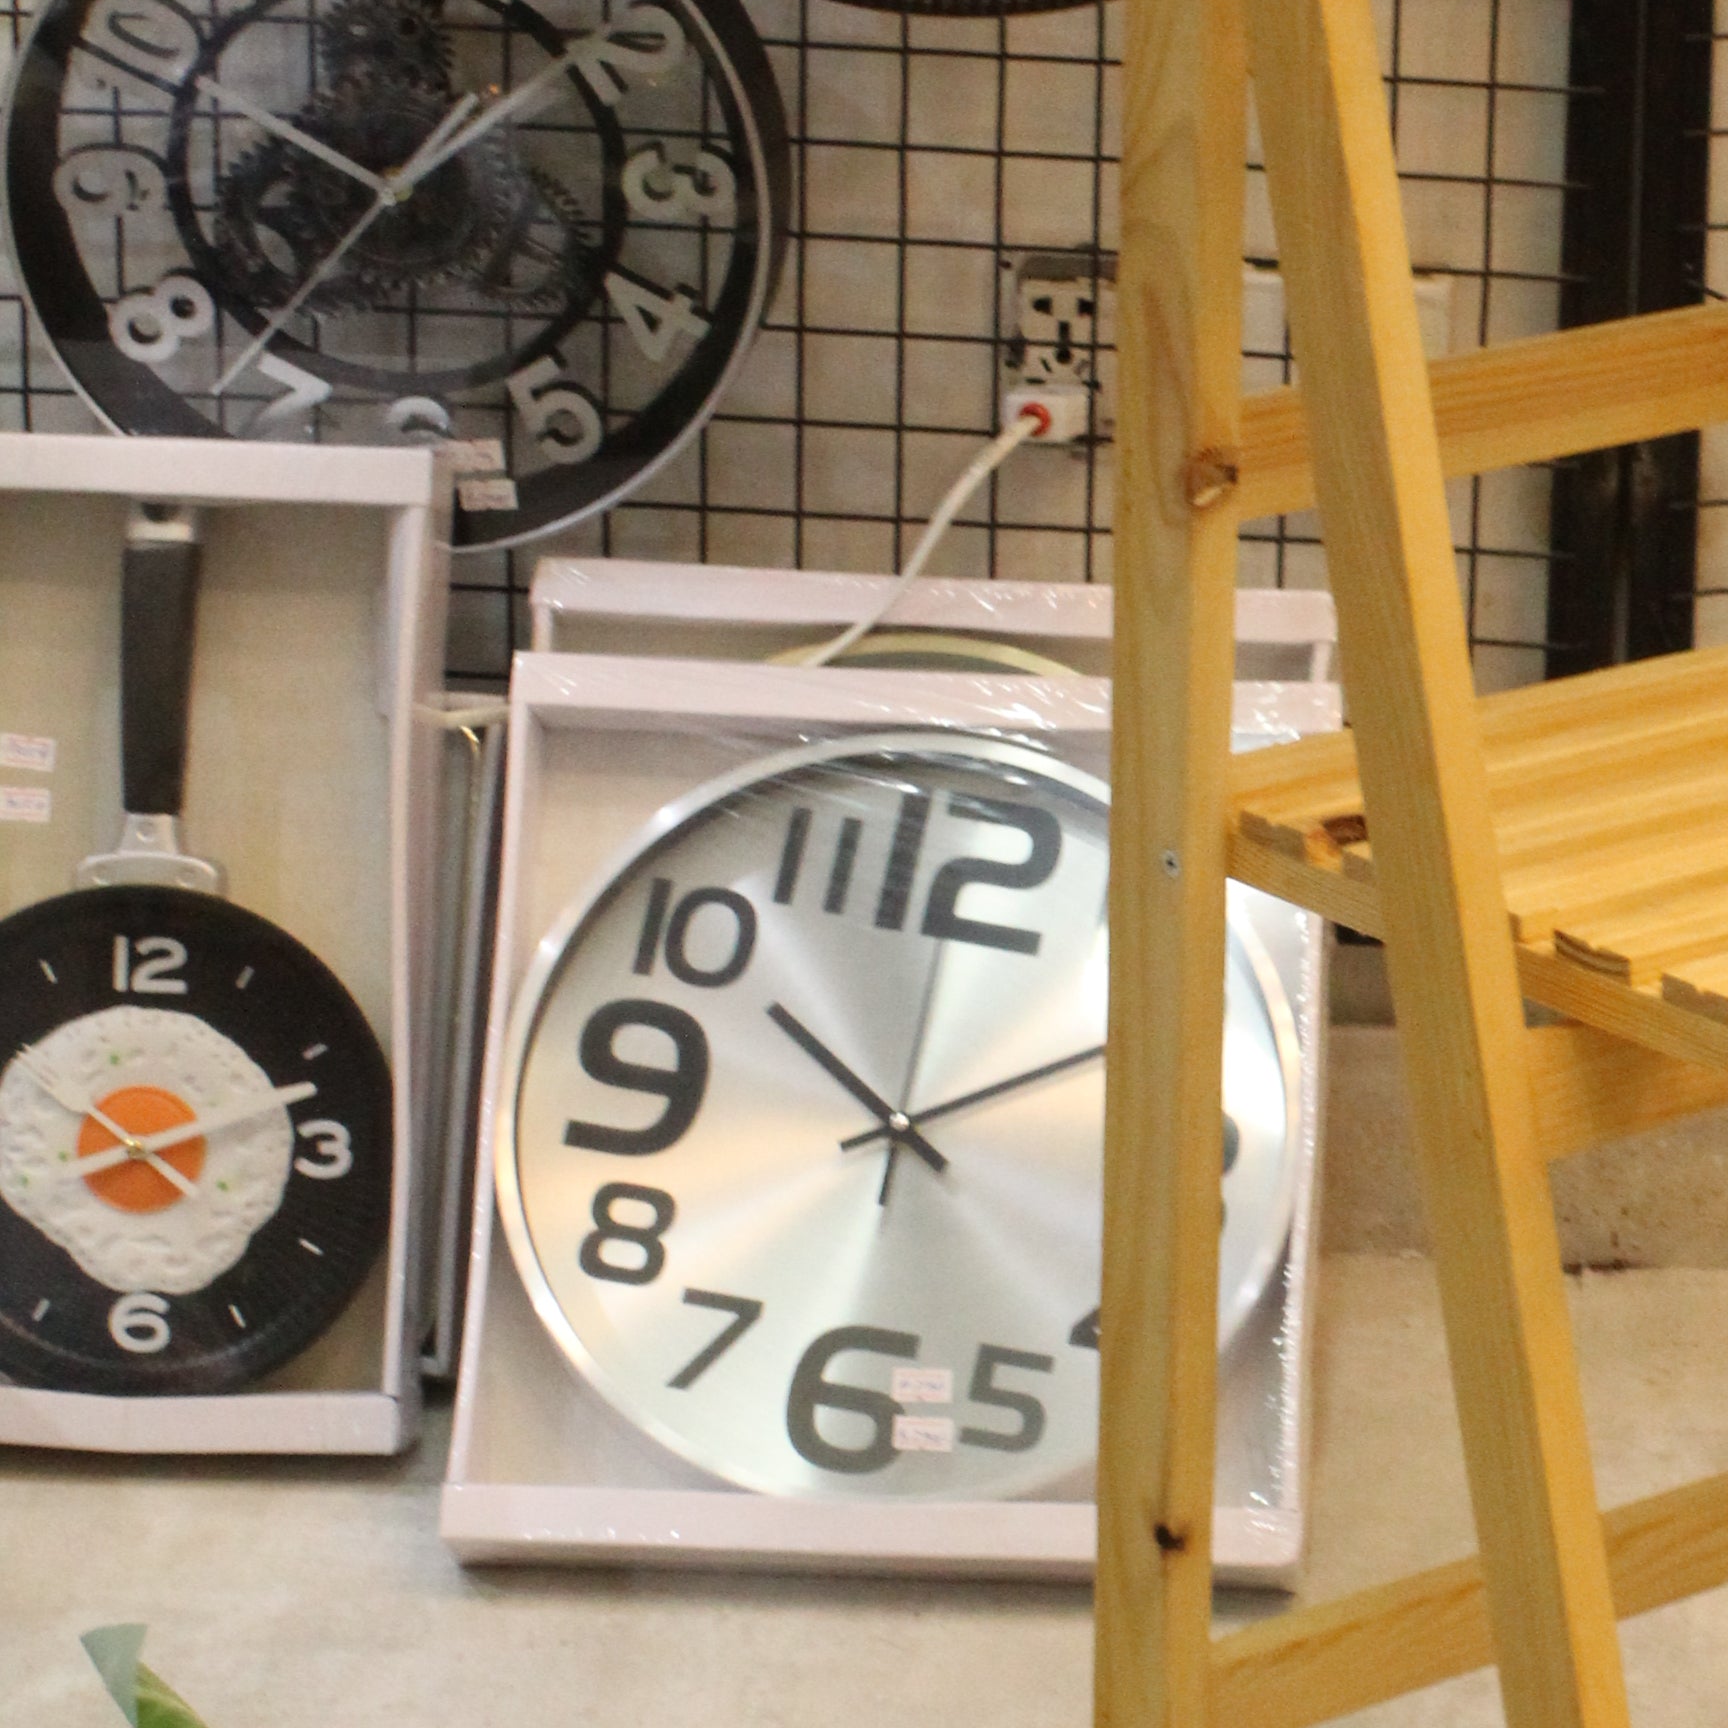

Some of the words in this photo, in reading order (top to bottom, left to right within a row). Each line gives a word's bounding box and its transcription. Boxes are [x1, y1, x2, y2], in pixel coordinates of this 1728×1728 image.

[620, 144, 739, 222] 3
[108, 273, 215, 365] 8
[603, 270, 713, 364] 4
[505, 355, 603, 465] 5
[773, 808, 863, 915] 11
[874, 790, 1063, 956] 12
[113, 934, 188, 994] 12
[632, 878, 758, 988] 10
[563, 998, 710, 1157] 9
[294, 1119, 352, 1179] 3
[578, 1182, 675, 1285] 8
[108, 1292, 170, 1354] 6
[667, 1288, 764, 1390] 7
[784, 1325, 924, 1473] 6
[959, 1343, 1055, 1454] 5
